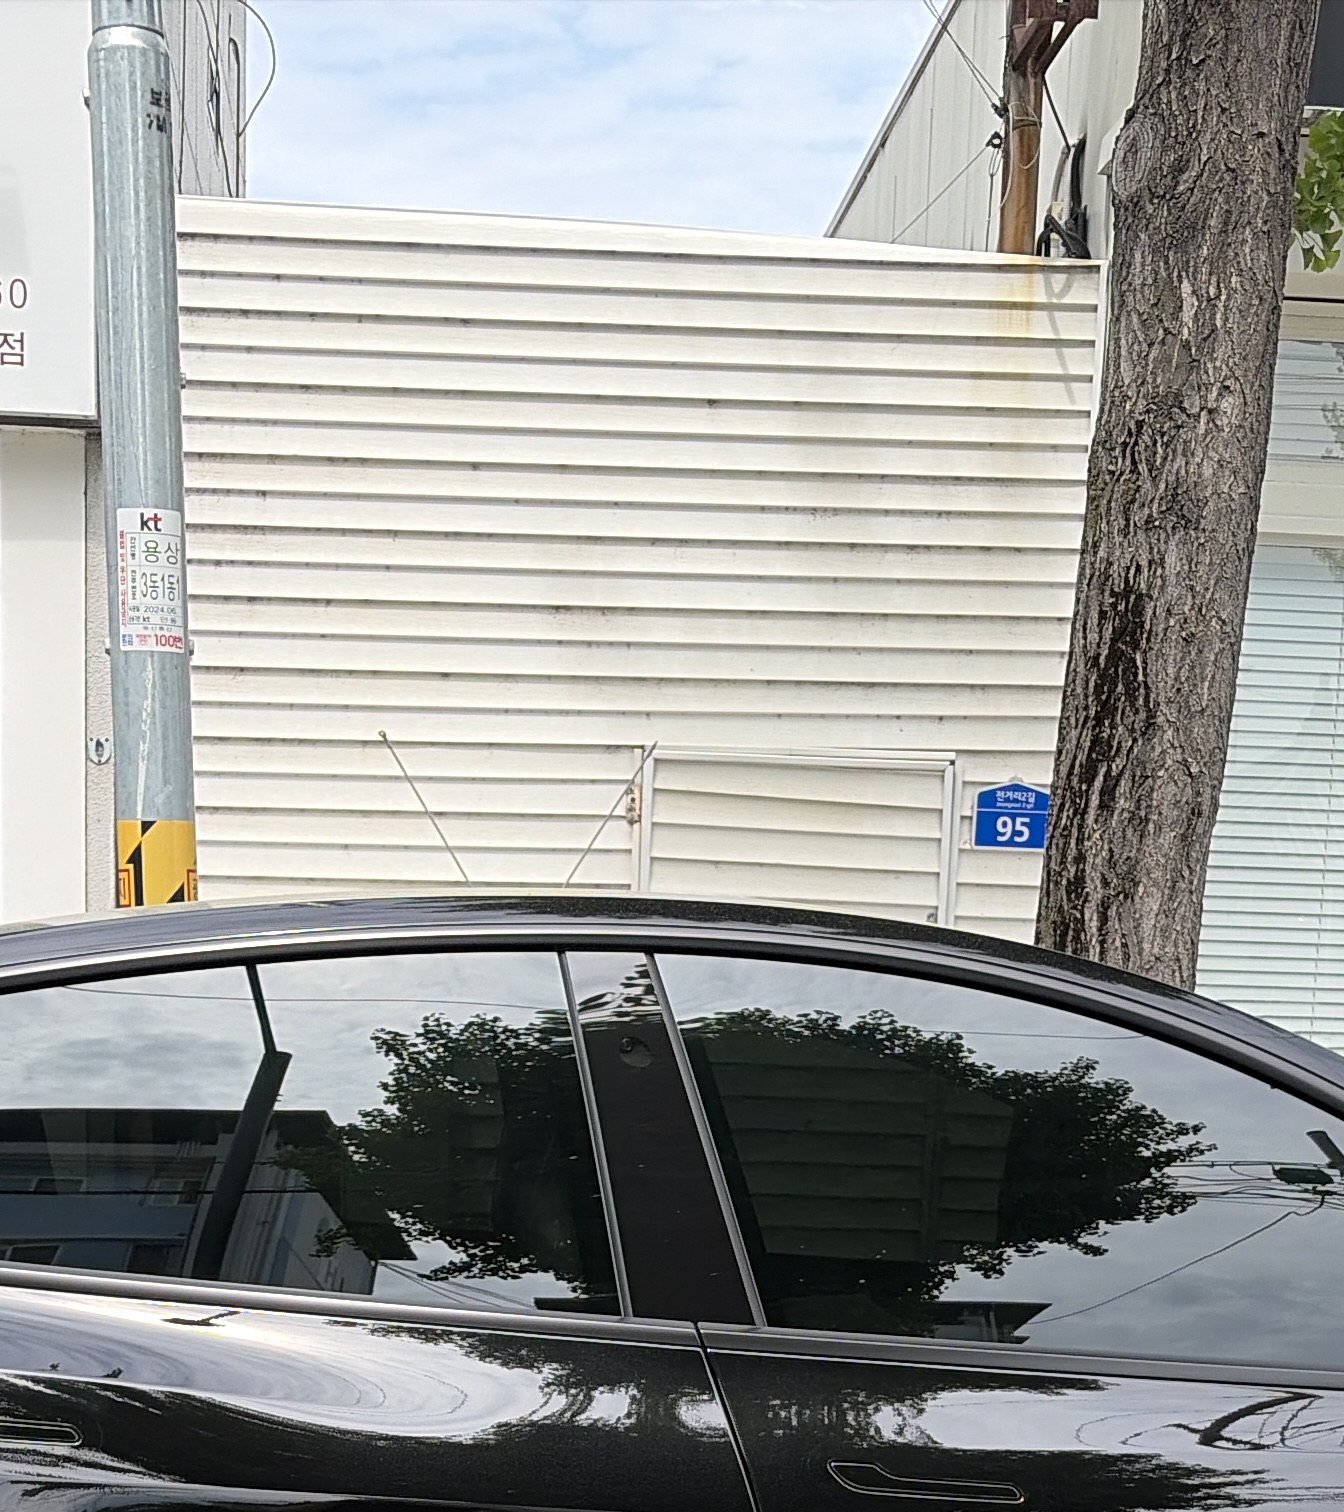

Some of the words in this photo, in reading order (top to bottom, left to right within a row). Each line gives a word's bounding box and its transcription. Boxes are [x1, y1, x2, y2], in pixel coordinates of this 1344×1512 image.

[140, 512, 162, 532] kt
[154, 634, 183, 649] 100번
[996, 816, 1030, 843] 95
